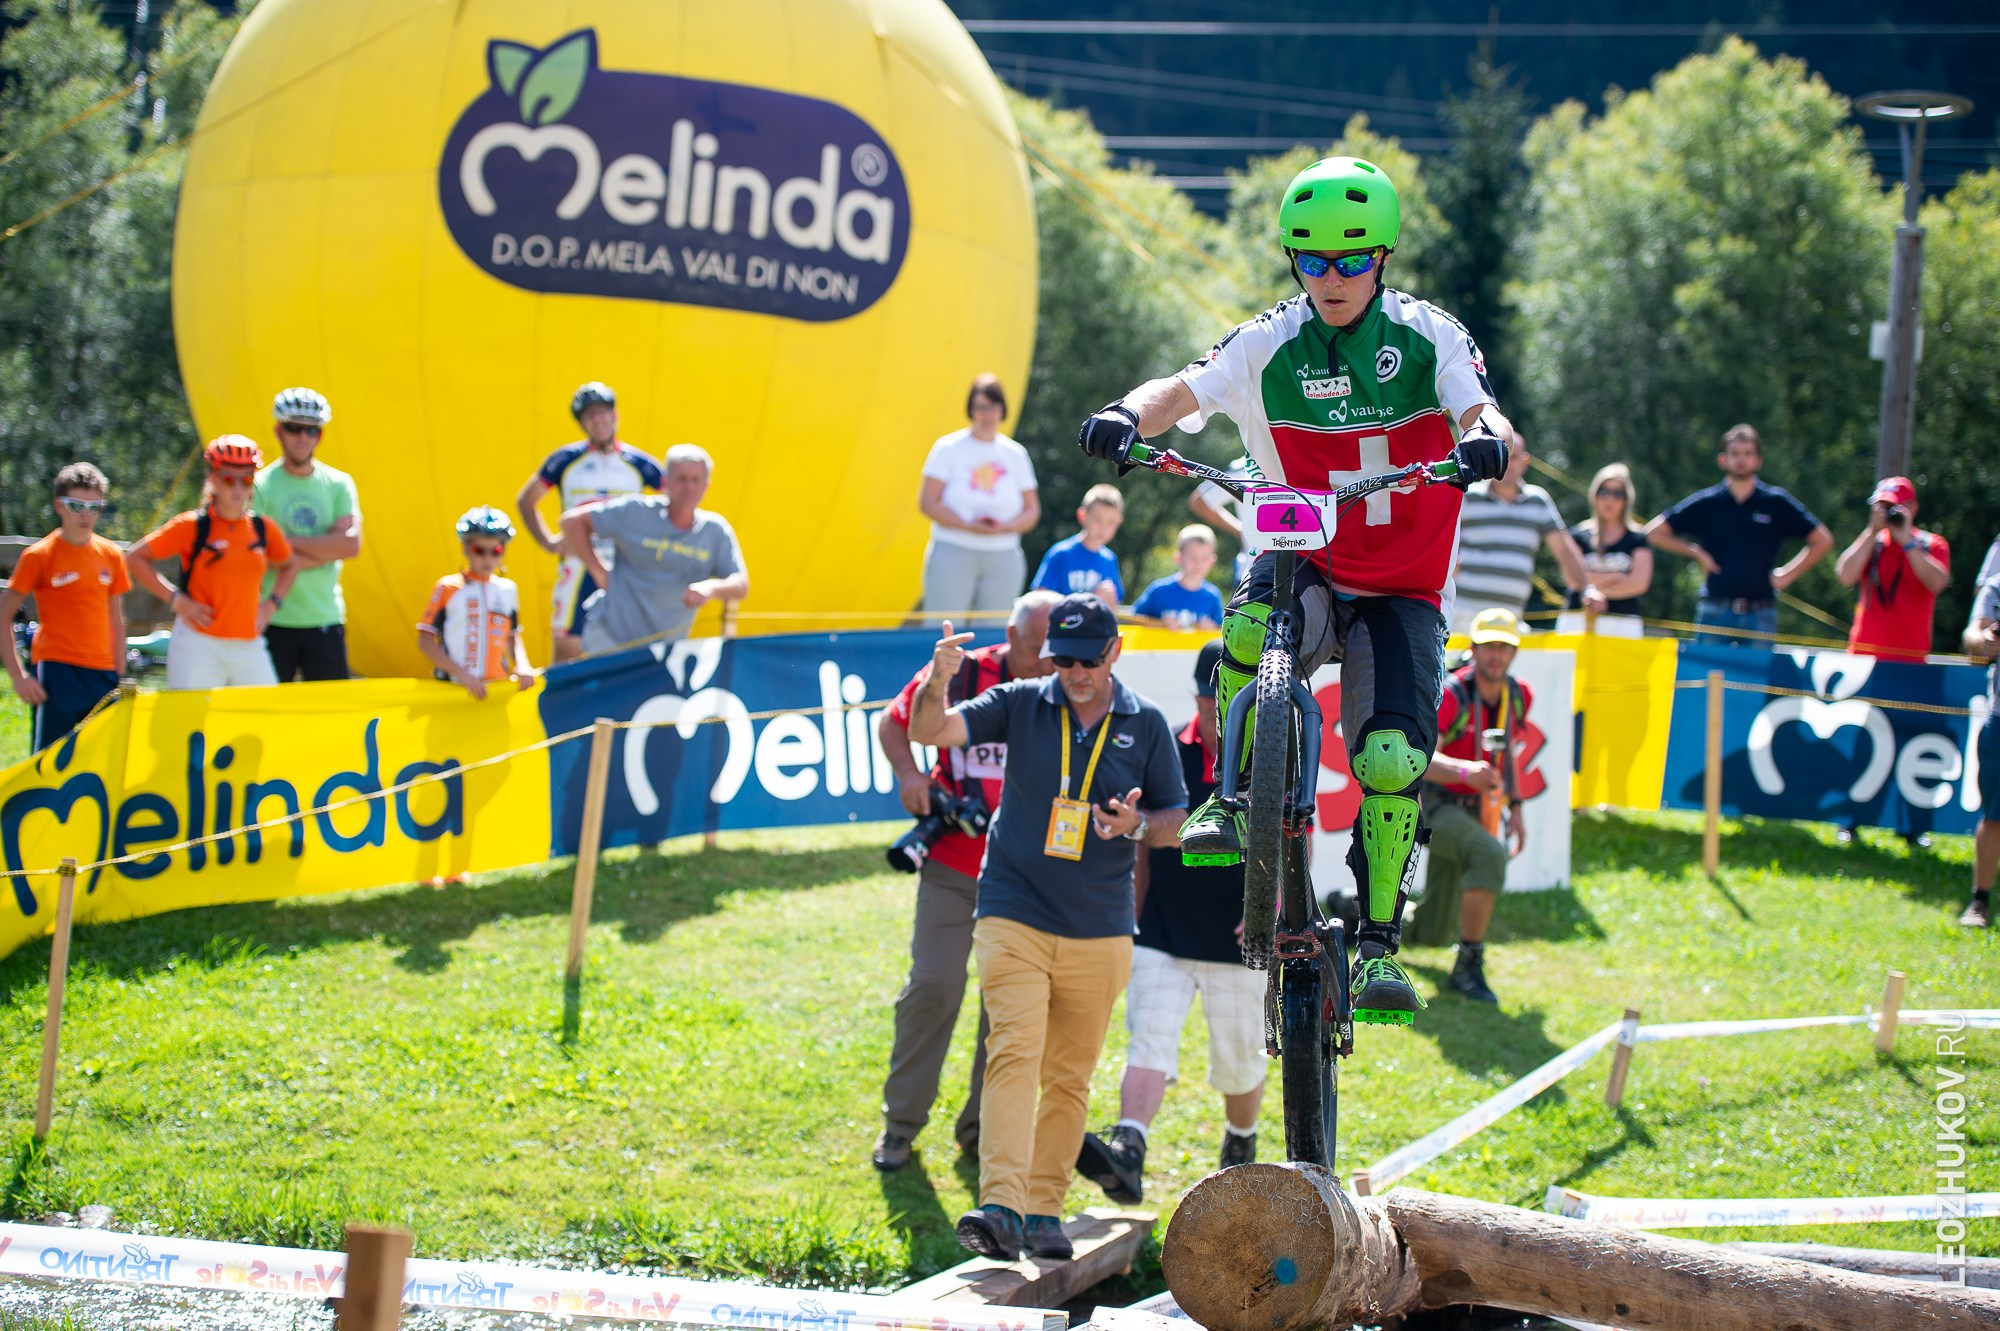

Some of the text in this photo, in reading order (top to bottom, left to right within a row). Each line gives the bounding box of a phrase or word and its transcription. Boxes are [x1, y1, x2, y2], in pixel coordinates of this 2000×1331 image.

[460, 119, 895, 264] Melinda
[583, 239, 675, 277] MELA
[681, 247, 741, 285] VAL
[746, 255, 779, 290] DI
[783, 262, 859, 304] NON
[1280, 506, 1299, 530] 4
[1335, 475, 1383, 500] BONZ
[1272, 538, 1306, 548] TRENTINO
[624, 660, 937, 815] Melin
[2, 718, 464, 916] Melinda
